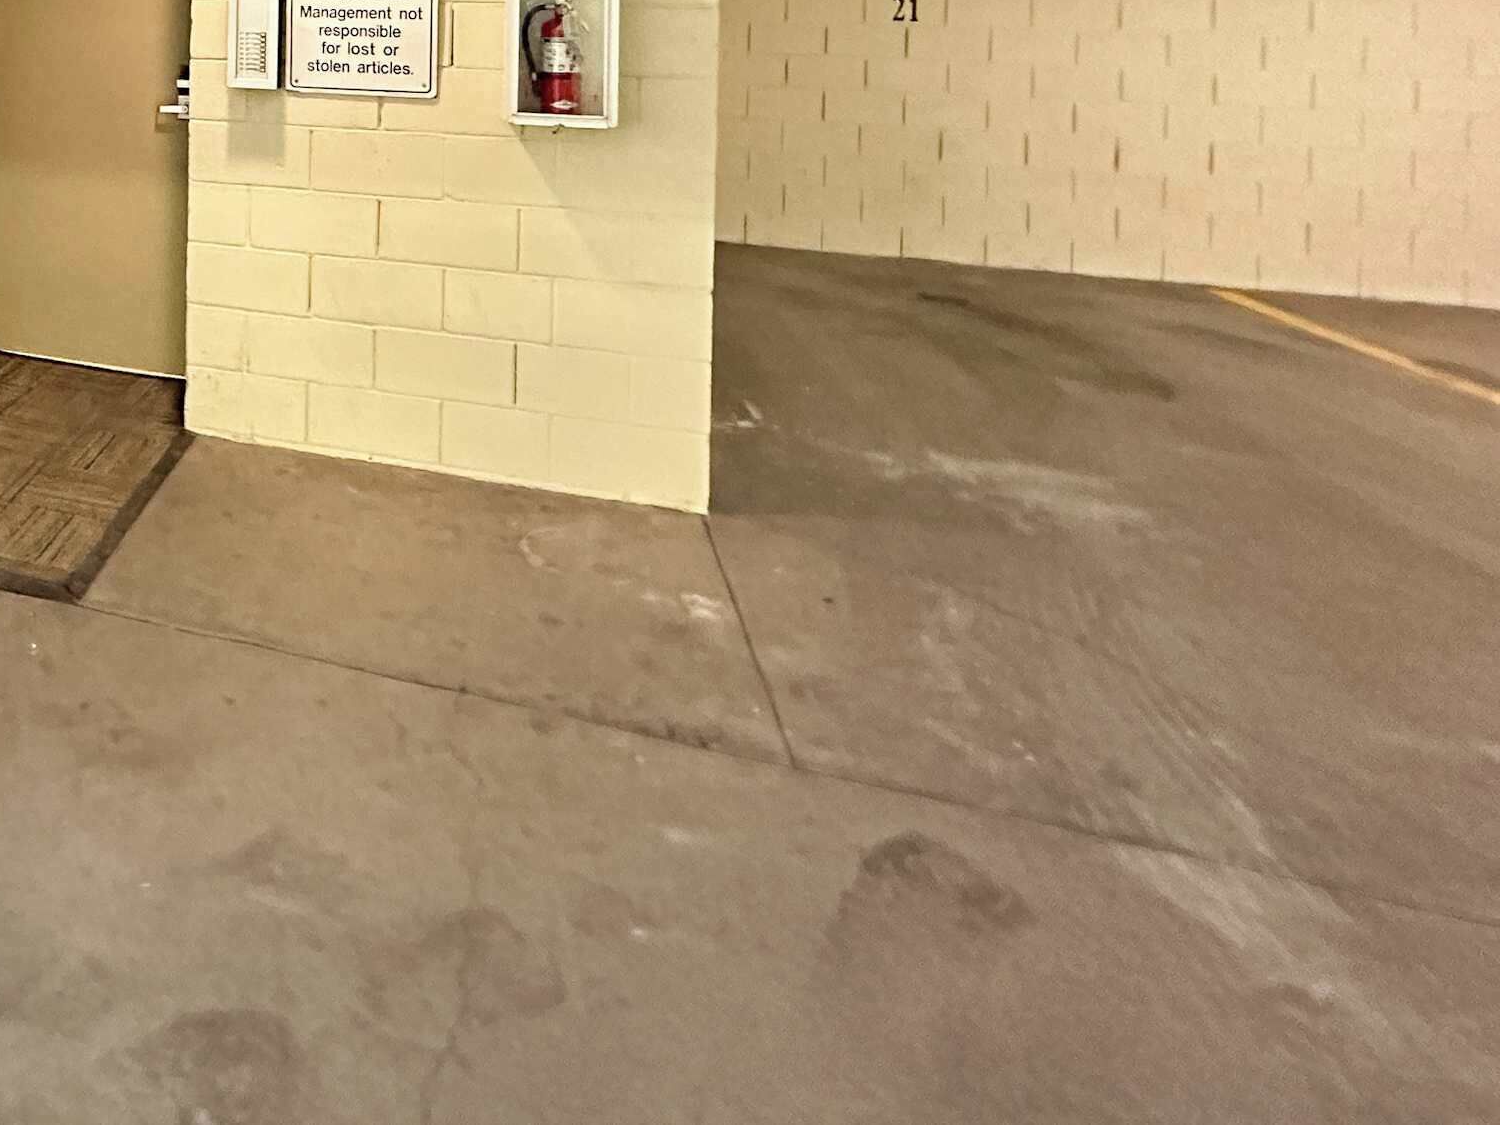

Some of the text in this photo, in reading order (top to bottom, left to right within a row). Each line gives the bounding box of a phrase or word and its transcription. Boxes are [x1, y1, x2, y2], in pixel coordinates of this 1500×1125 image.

[300, 5, 424, 22] Management not
[318, 24, 402, 41] responsible
[321, 41, 400, 56] for lost or
[307, 60, 415, 76] stolen articles.
